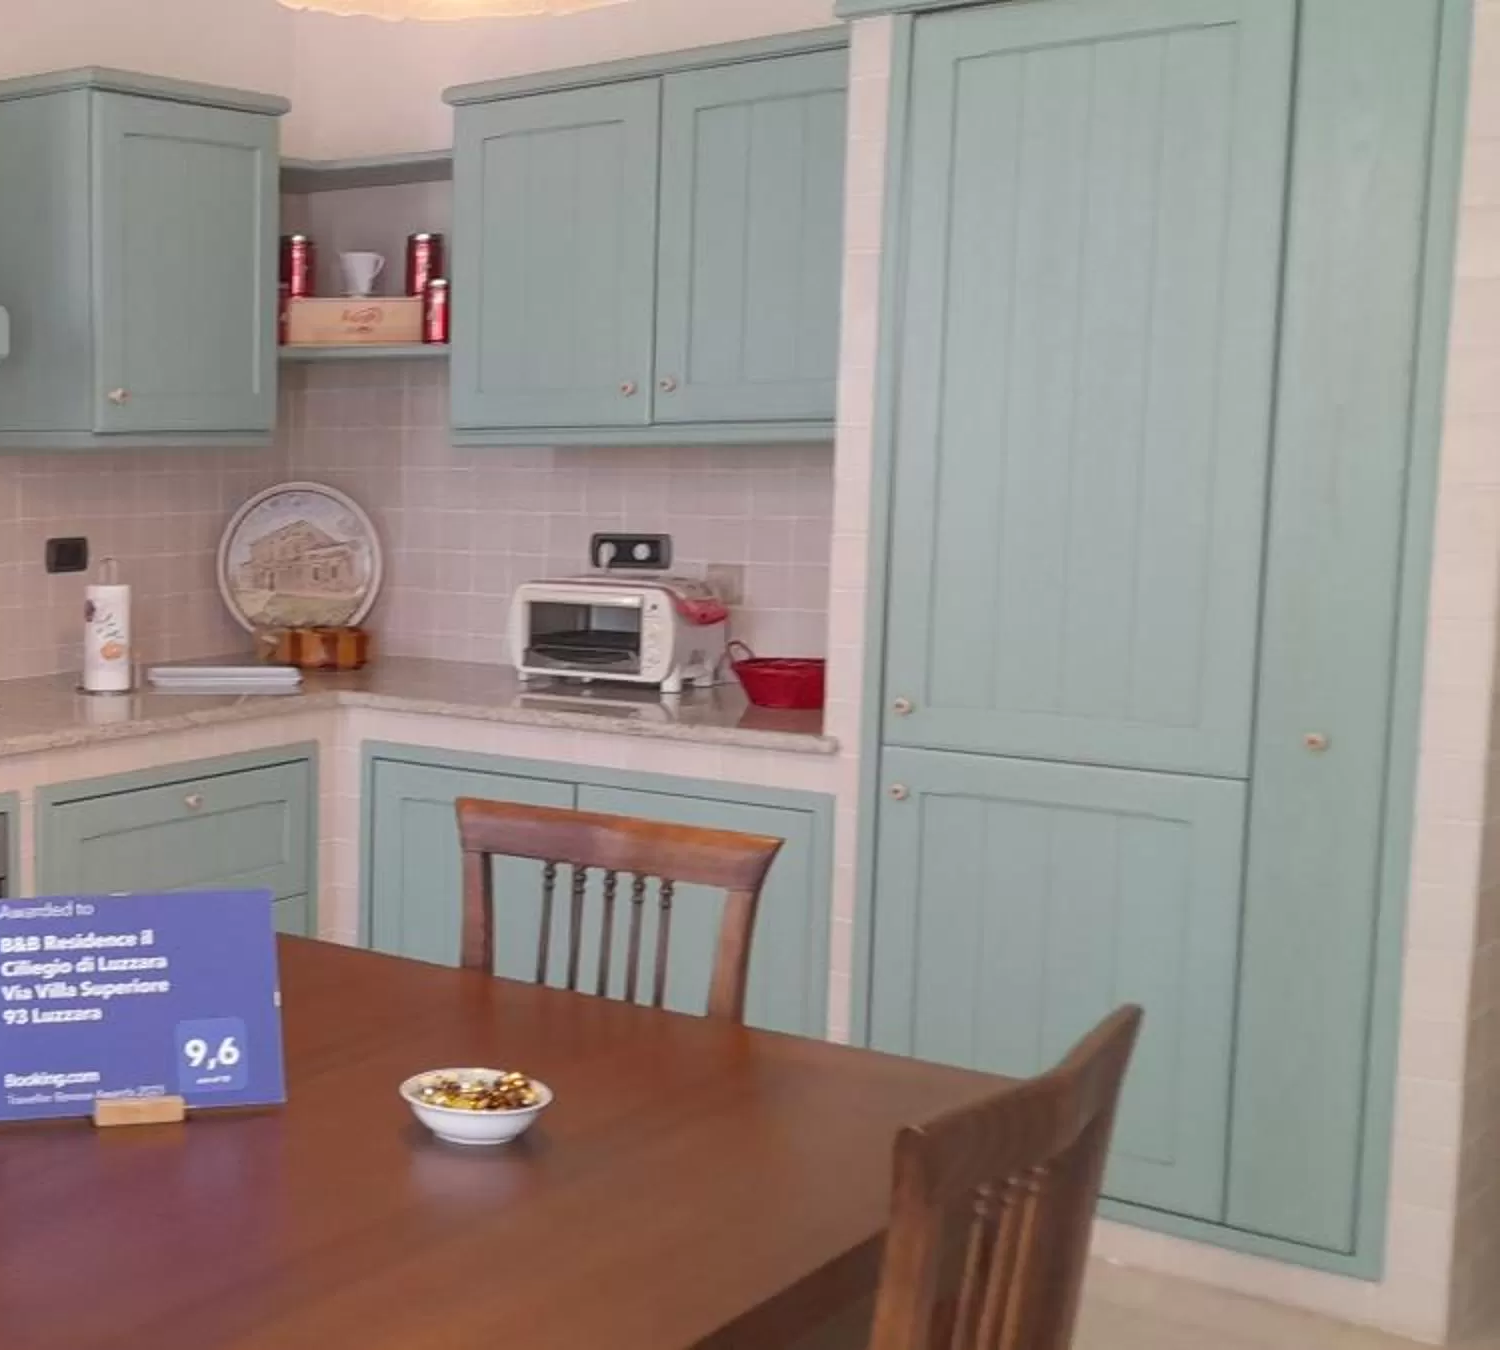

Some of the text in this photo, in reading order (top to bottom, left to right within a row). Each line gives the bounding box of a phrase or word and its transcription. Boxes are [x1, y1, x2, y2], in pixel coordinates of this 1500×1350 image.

[75, 903, 95, 916] to
[0, 935, 41, 953] B&B
[43, 931, 138, 951] Residence
[0, 956, 168, 979] Ciliegio di Luzzara
[1, 978, 170, 1001] Via Villa Superiore
[2, 1007, 103, 1025] 93 Luzzara
[184, 1036, 241, 1071] 9,6
[3, 1071, 101, 1089] Booking.com
